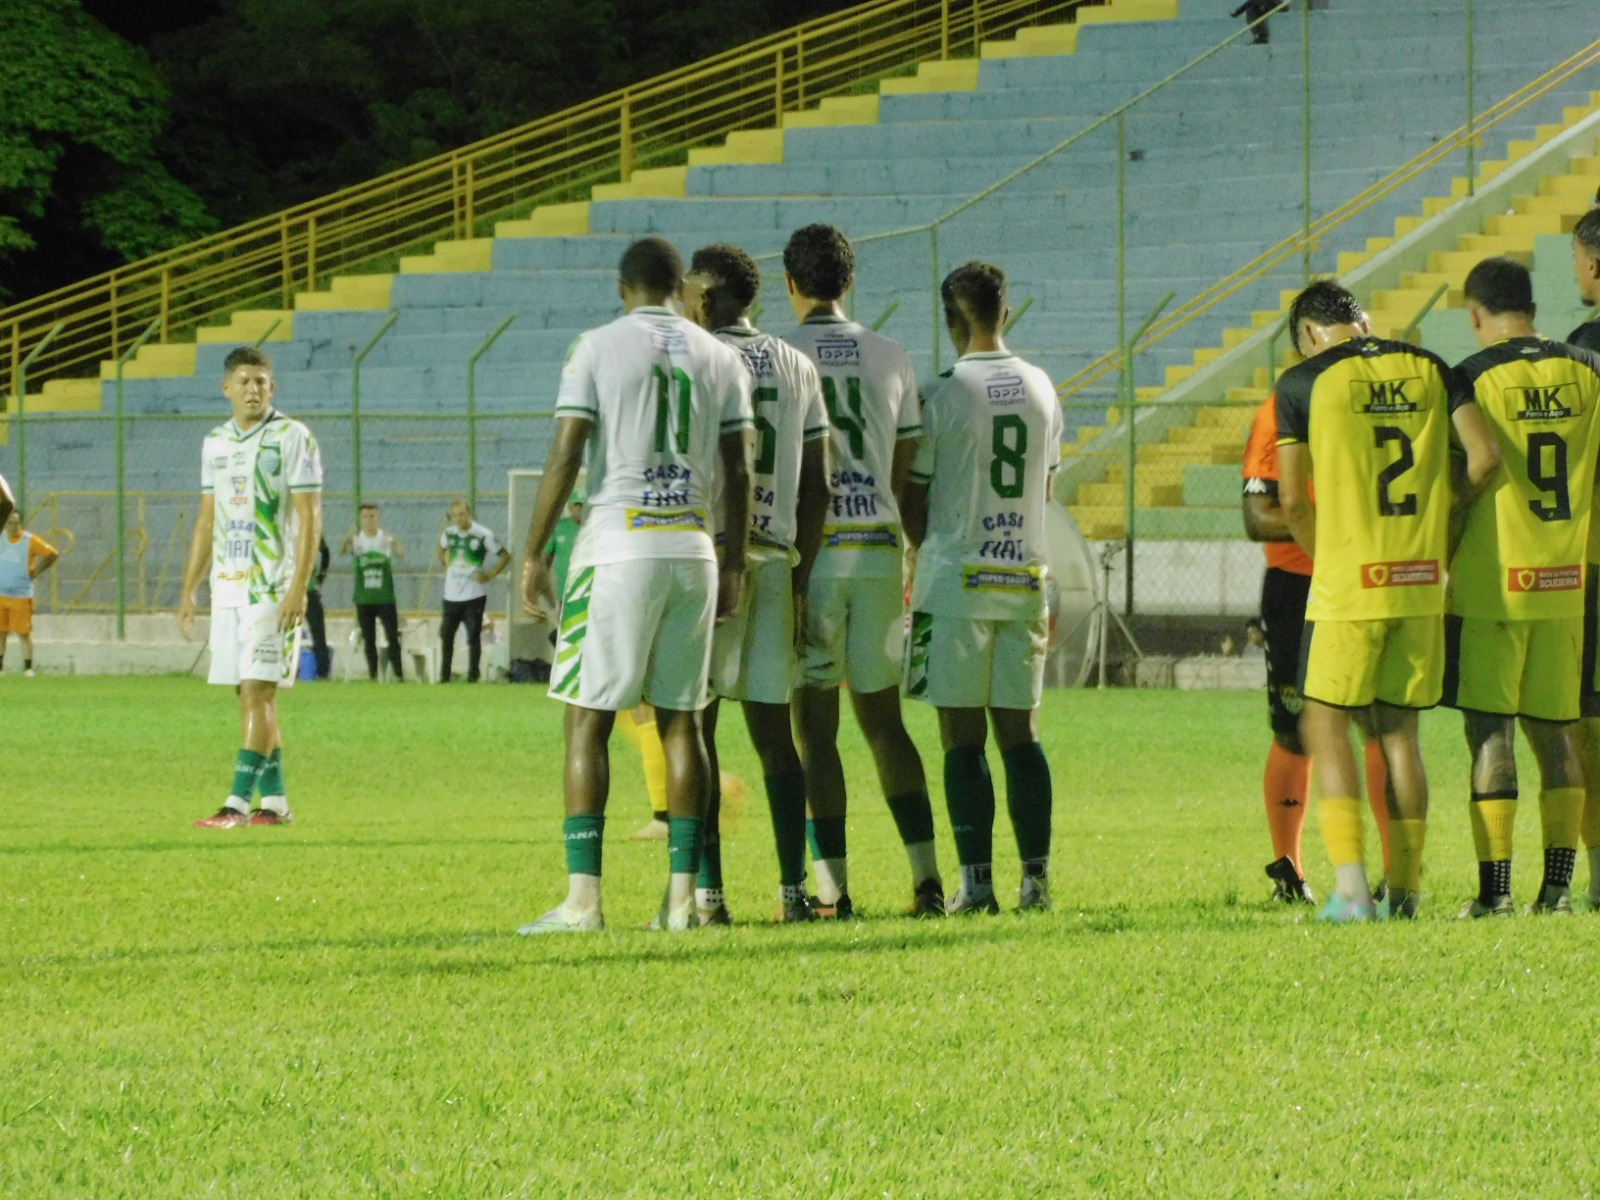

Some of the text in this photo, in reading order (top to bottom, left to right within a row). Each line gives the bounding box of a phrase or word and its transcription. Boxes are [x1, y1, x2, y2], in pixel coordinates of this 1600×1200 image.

[1369, 381, 1409, 404] MK
[1523, 386, 1564, 411] MK
[651, 362, 693, 454] 11
[820, 376, 867, 461] 4
[750, 386, 779, 475] 5
[990, 413, 1028, 499] 8
[643, 463, 691, 482] CASA
[830, 470, 876, 488] CASA
[1373, 426, 1417, 517] 2
[1527, 431, 1572, 522] 9
[832, 493, 878, 517] FIAT
[224, 539, 253, 559] FIAT
[979, 539, 1024, 562] FIAT
[1539, 577, 1578, 589] SCUDERIA
